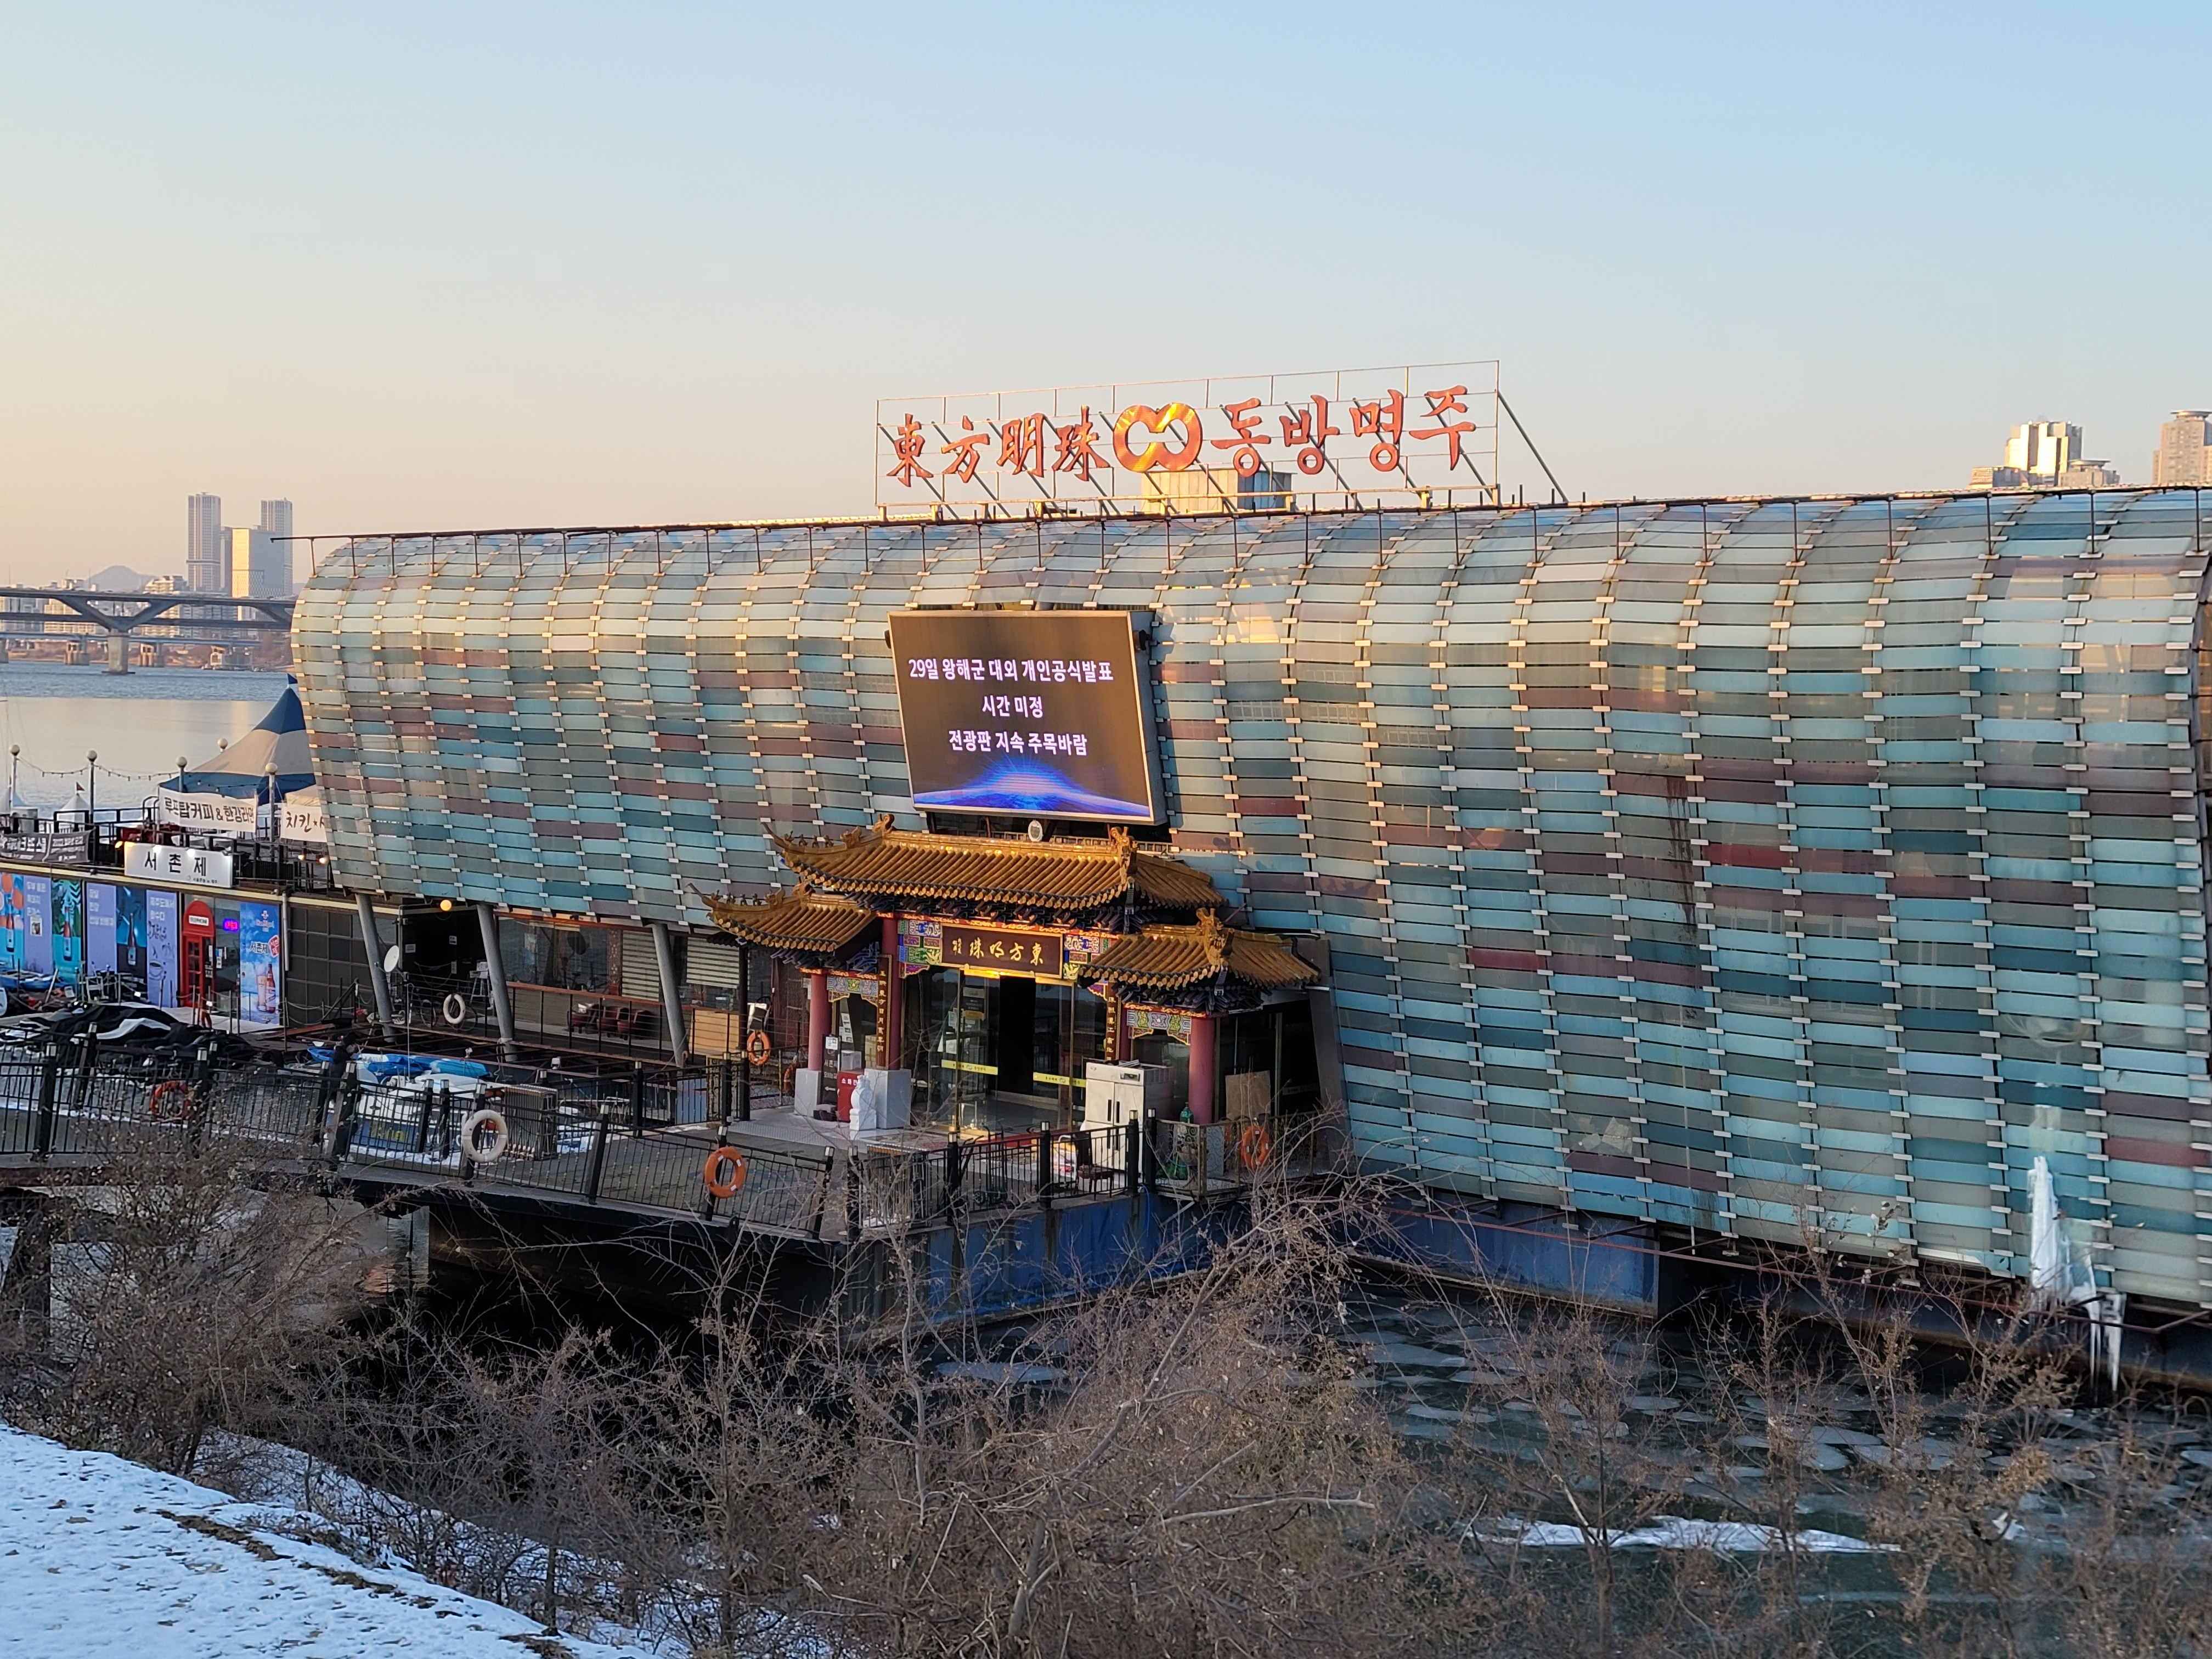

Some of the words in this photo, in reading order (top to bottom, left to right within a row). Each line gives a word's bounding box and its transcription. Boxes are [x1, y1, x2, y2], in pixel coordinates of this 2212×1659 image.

[1211, 385, 1476, 476] 동방명주
[887, 405, 1109, 487] 東方明珠
[909, 658, 939, 680] 29일
[943, 658, 985, 681] 왕해군
[989, 659, 1018, 681] 대외
[1022, 660, 1113, 682] 개인공식발표
[982, 695, 1009, 717] 시간
[1014, 696, 1043, 718] 미정
[949, 730, 991, 752] 전광판
[995, 732, 1024, 753] 지속
[1028, 733, 1087, 756] 주목바람
[216, 808, 223, 821] &
[223, 805, 254, 823] 한강라면
[144, 851, 206, 876] 서촌제
[251, 941, 268, 954] 서촌제
